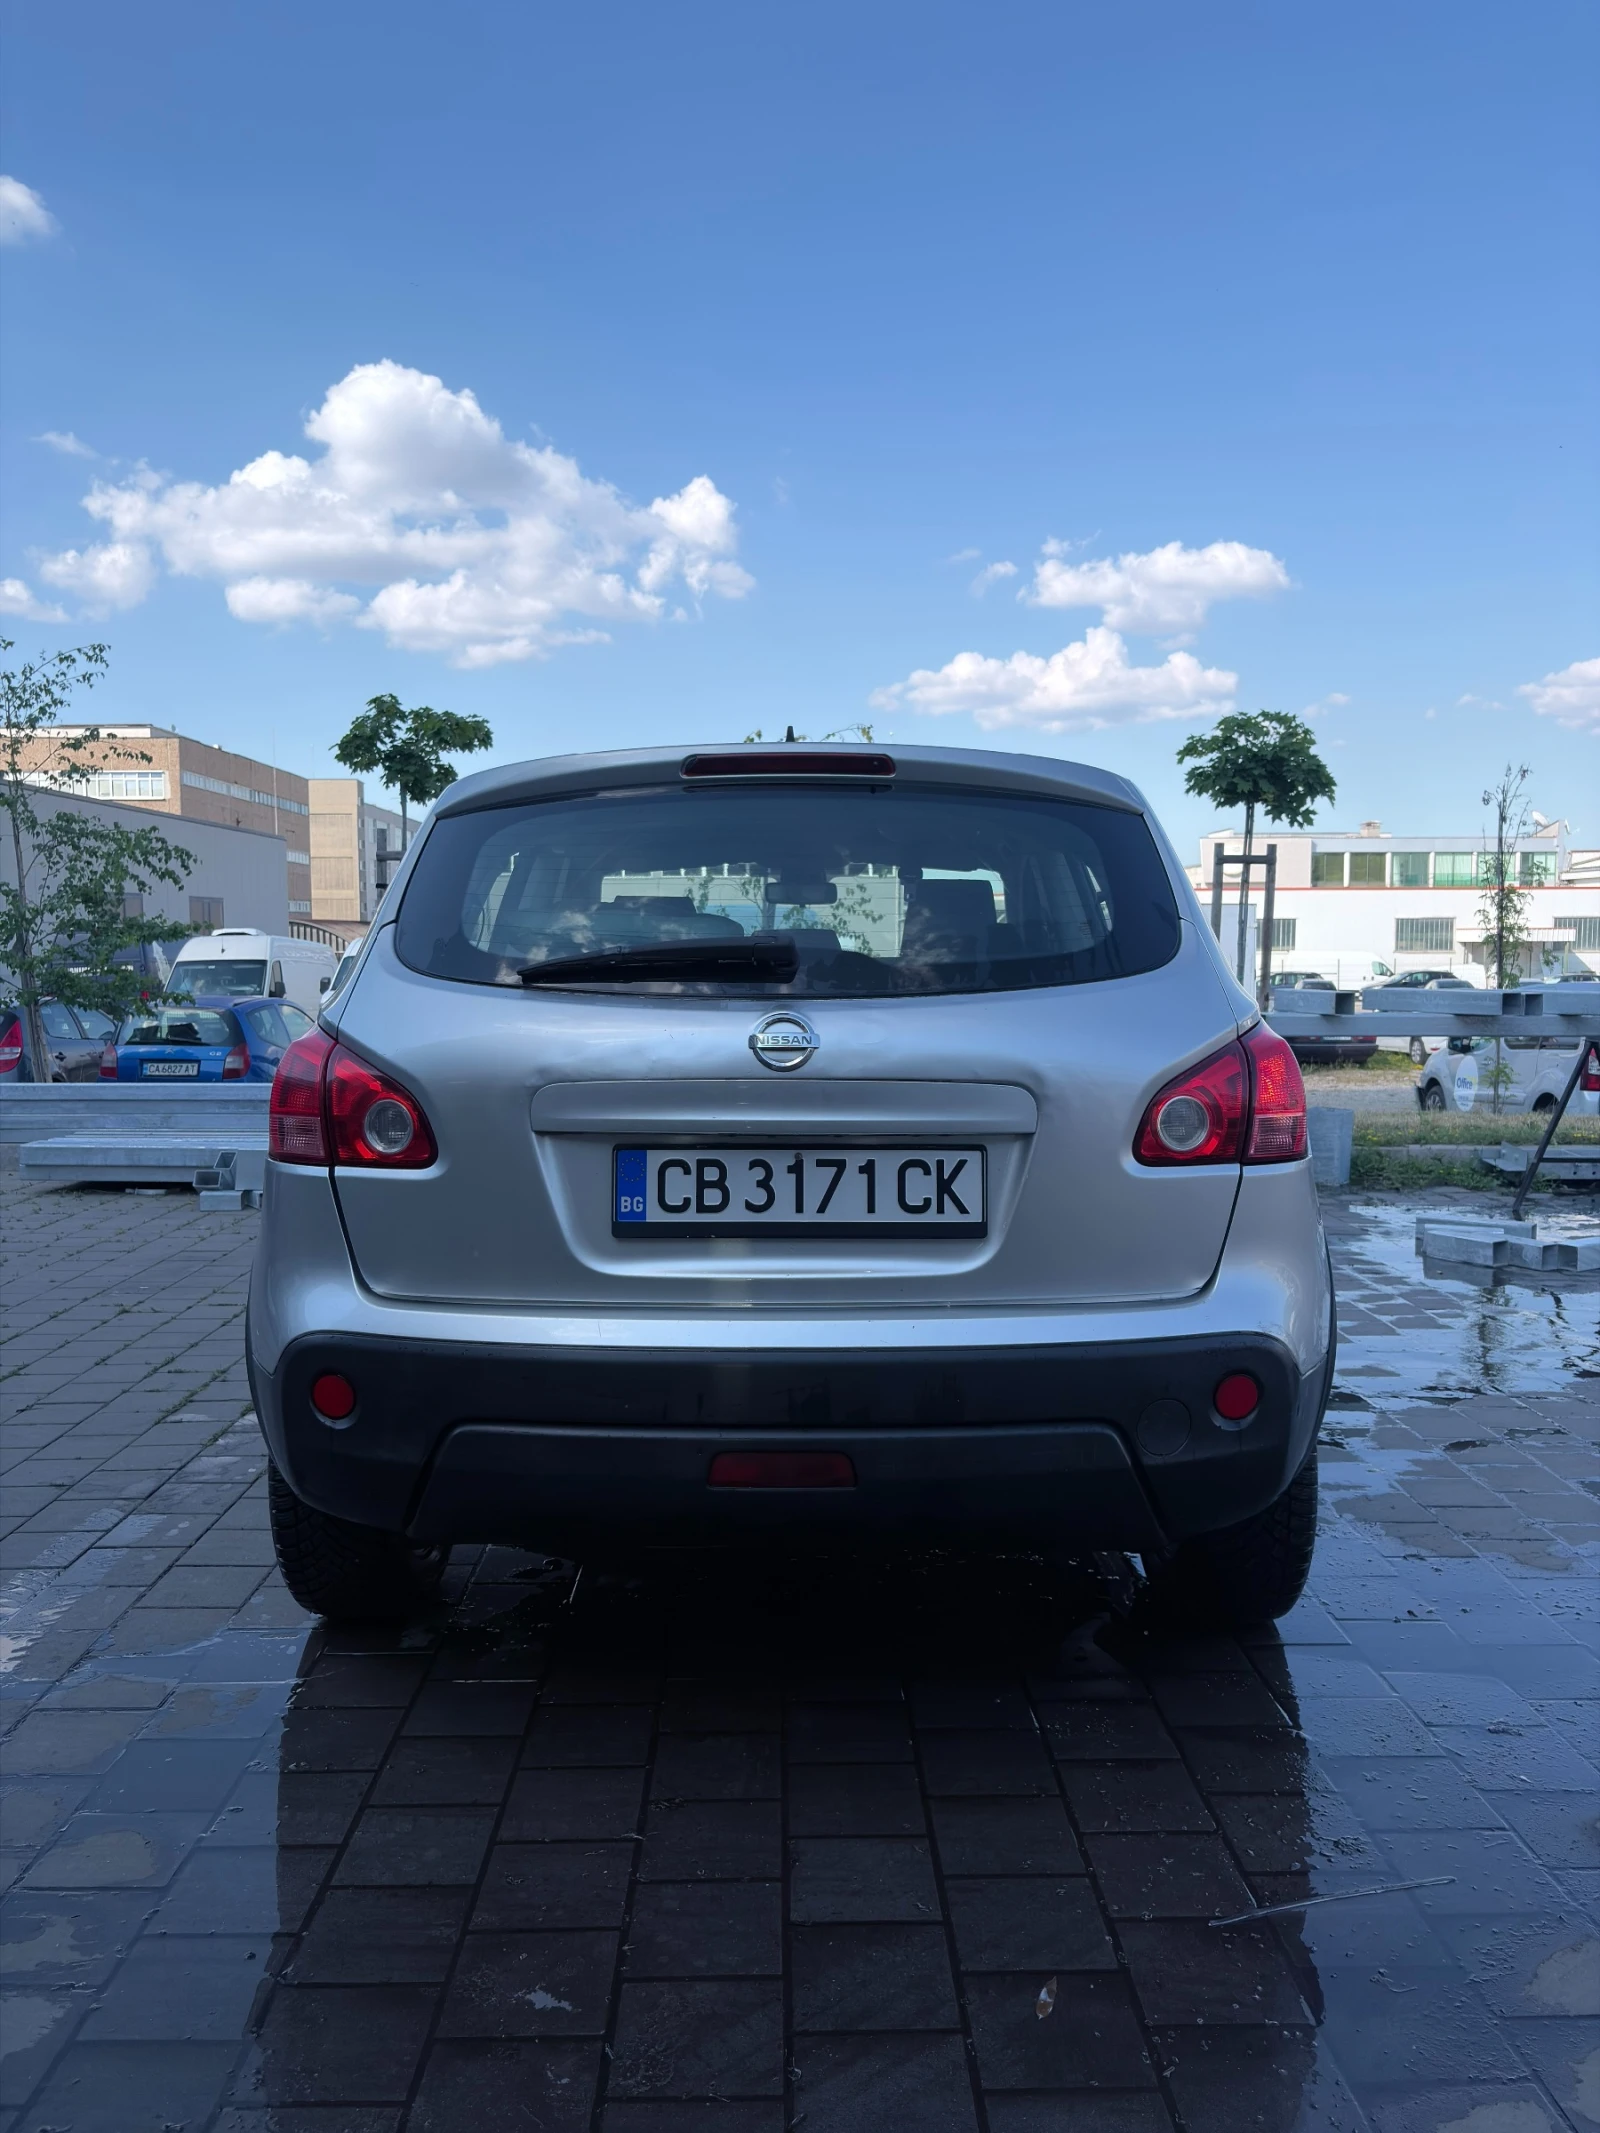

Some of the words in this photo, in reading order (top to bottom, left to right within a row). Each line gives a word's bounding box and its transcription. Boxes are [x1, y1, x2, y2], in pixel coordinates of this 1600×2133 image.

[756, 1035, 812, 1045] NISSAN
[149, 1064, 160, 1074] CA
[184, 1064, 196, 1074] AT
[1456, 1077, 1473, 1090] Office
[657, 1158, 731, 1214] CB
[744, 1158, 876, 1214] 3171
[897, 1158, 971, 1214] CK
[620, 1196, 644, 1213] BG
